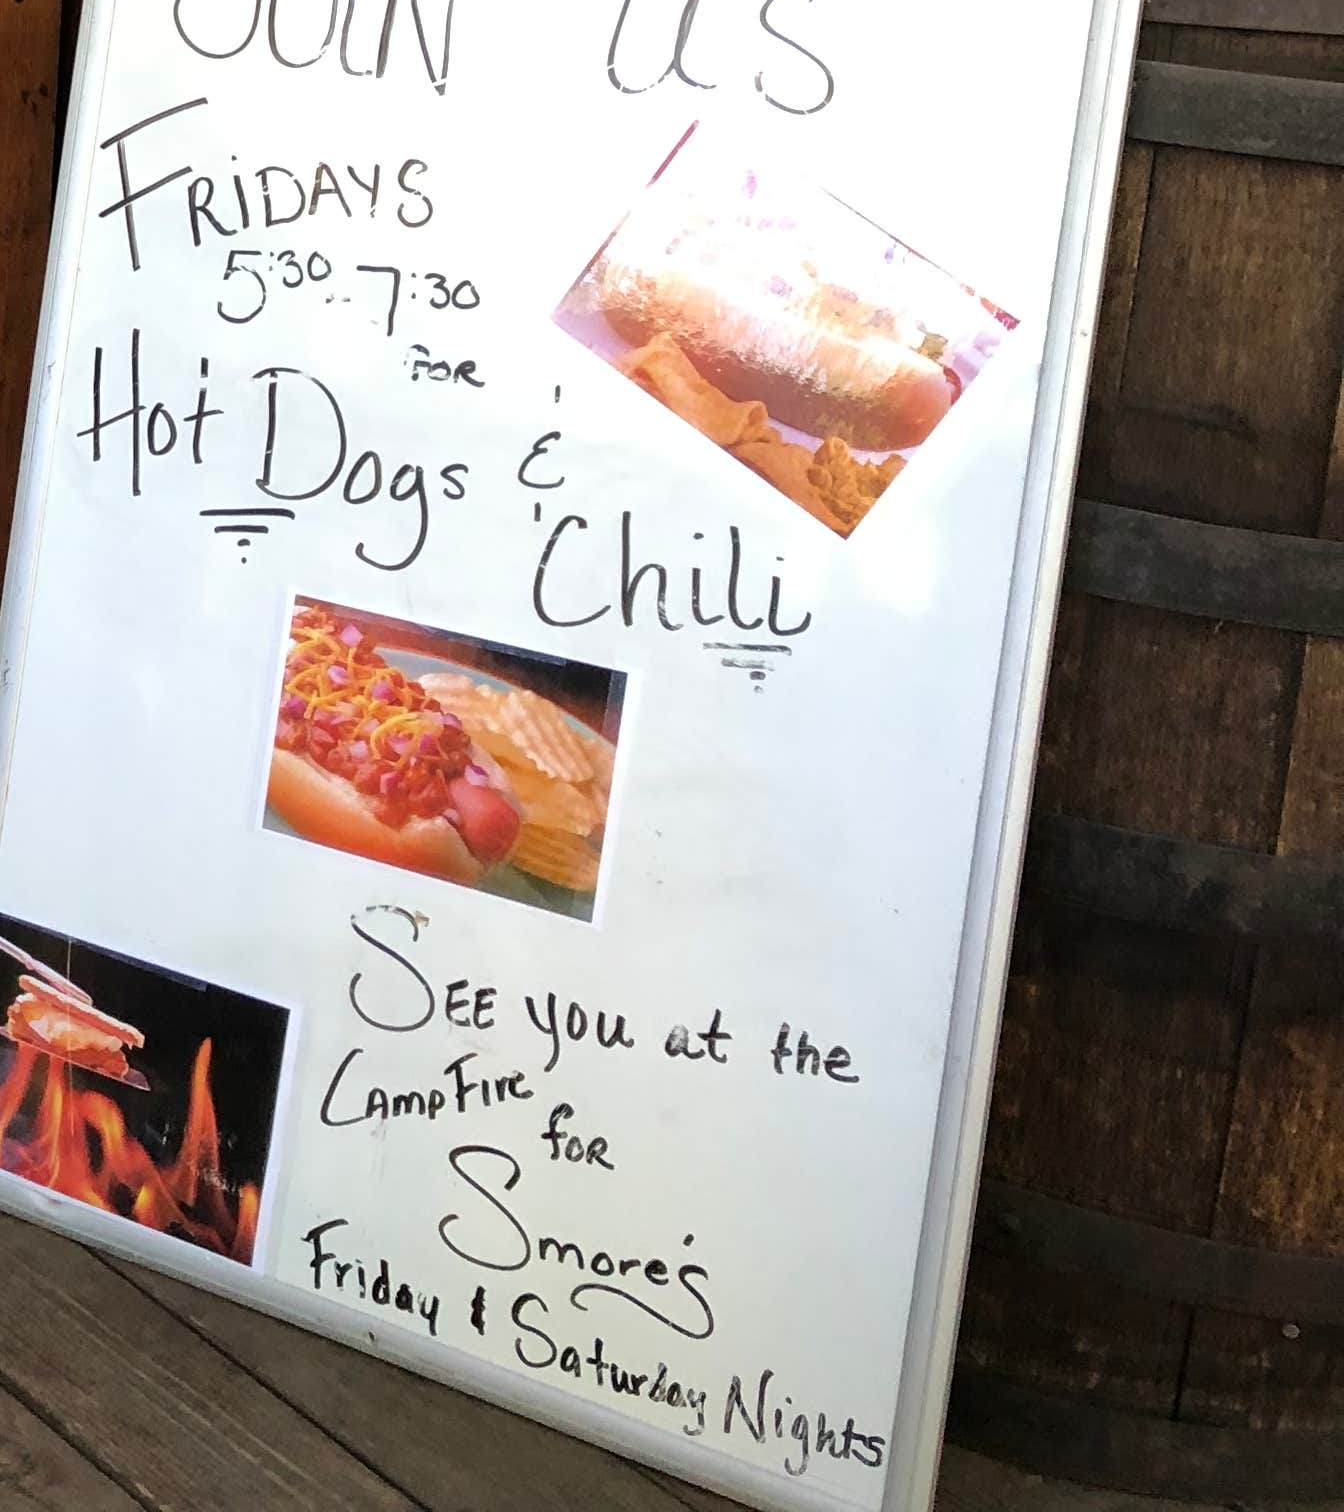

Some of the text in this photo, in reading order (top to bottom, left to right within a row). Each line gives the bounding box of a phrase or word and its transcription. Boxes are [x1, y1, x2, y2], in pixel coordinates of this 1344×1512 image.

[354, 262, 482, 339] 7:30
[76, 328, 225, 497] Hot
[253, 365, 469, 571] Dogs
[533, 516, 813, 637] Chili
[525, 992, 635, 1073] you
[663, 1008, 730, 1065] at
[770, 1021, 862, 1085] the
[301, 1219, 441, 1336] Friday
[513, 1292, 707, 1436] Saturday
[724, 1370, 887, 1478] Nights
